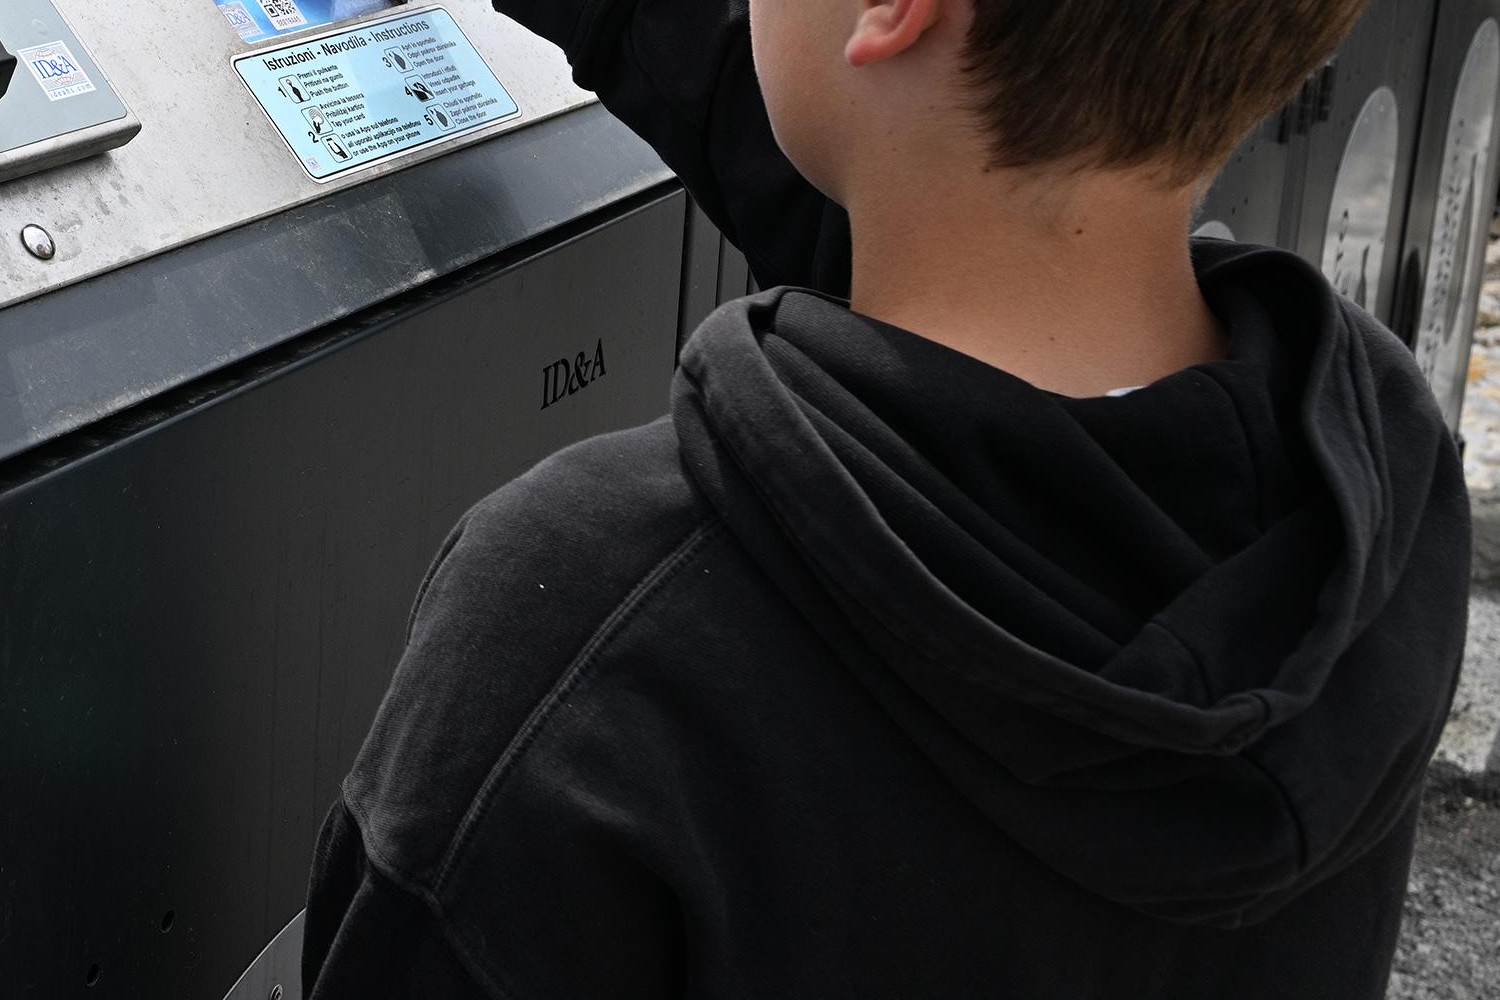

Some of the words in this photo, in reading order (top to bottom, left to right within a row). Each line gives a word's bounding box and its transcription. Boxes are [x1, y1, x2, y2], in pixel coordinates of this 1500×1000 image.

[263, 48, 316, 71] Istruzioni
[320, 34, 367, 56] Navodila
[370, 21, 430, 42] Instructions
[32, 56, 77, 79] ID&A
[382, 57, 392, 67] 3
[414, 59, 427, 67] Open
[297, 71, 313, 79] Premi
[317, 64, 339, 75] pulsante
[278, 87, 287, 98] 1
[310, 89, 324, 97] Push
[332, 82, 349, 90] button
[404, 86, 414, 97] 4
[319, 99, 341, 109] Avvicina
[346, 93, 364, 101] tessera
[332, 120, 343, 128] Tap
[353, 113, 365, 121] card
[360, 125, 372, 133] App
[378, 117, 399, 126] telefono
[424, 115, 434, 125] 5
[308, 131, 318, 142] 2
[376, 141, 389, 149] App
[405, 130, 421, 139] phone
[540, 337, 606, 410] ID&A
